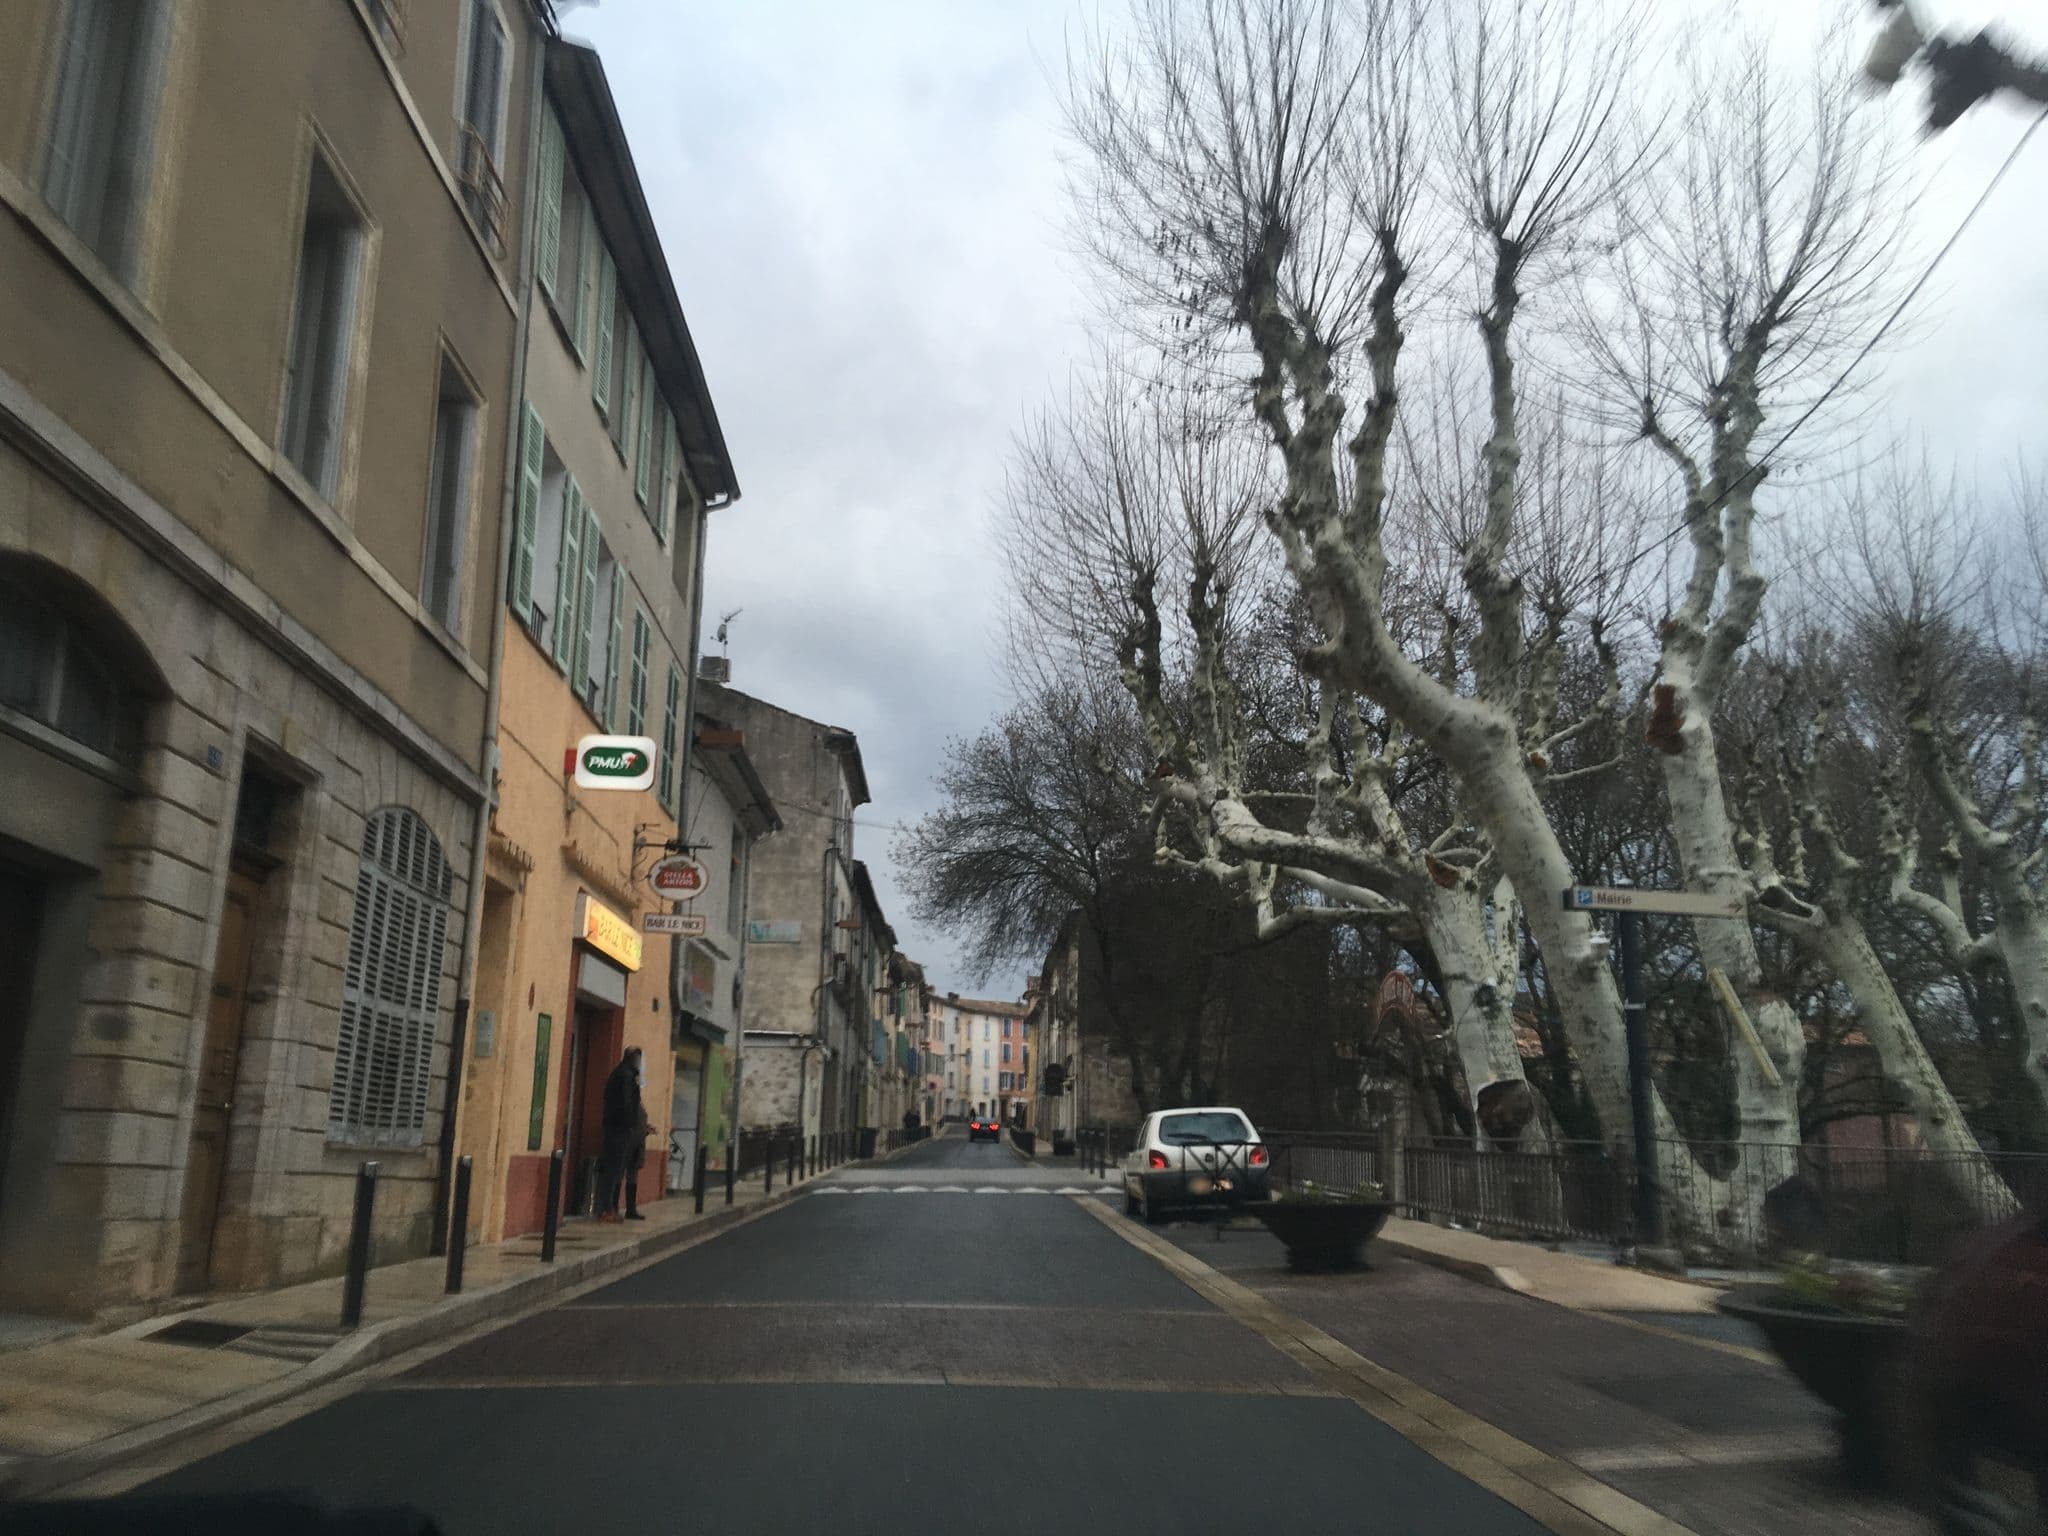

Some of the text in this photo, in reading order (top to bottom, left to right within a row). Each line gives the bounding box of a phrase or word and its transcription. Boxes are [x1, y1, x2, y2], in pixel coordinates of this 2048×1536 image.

[588, 755, 622, 769] PMU
[664, 871, 694, 879] STELLA
[663, 879, 694, 887] ARTOIS
[1597, 892, 1633, 905] Mairie
[646, 918, 704, 931] BAR LE NICE
